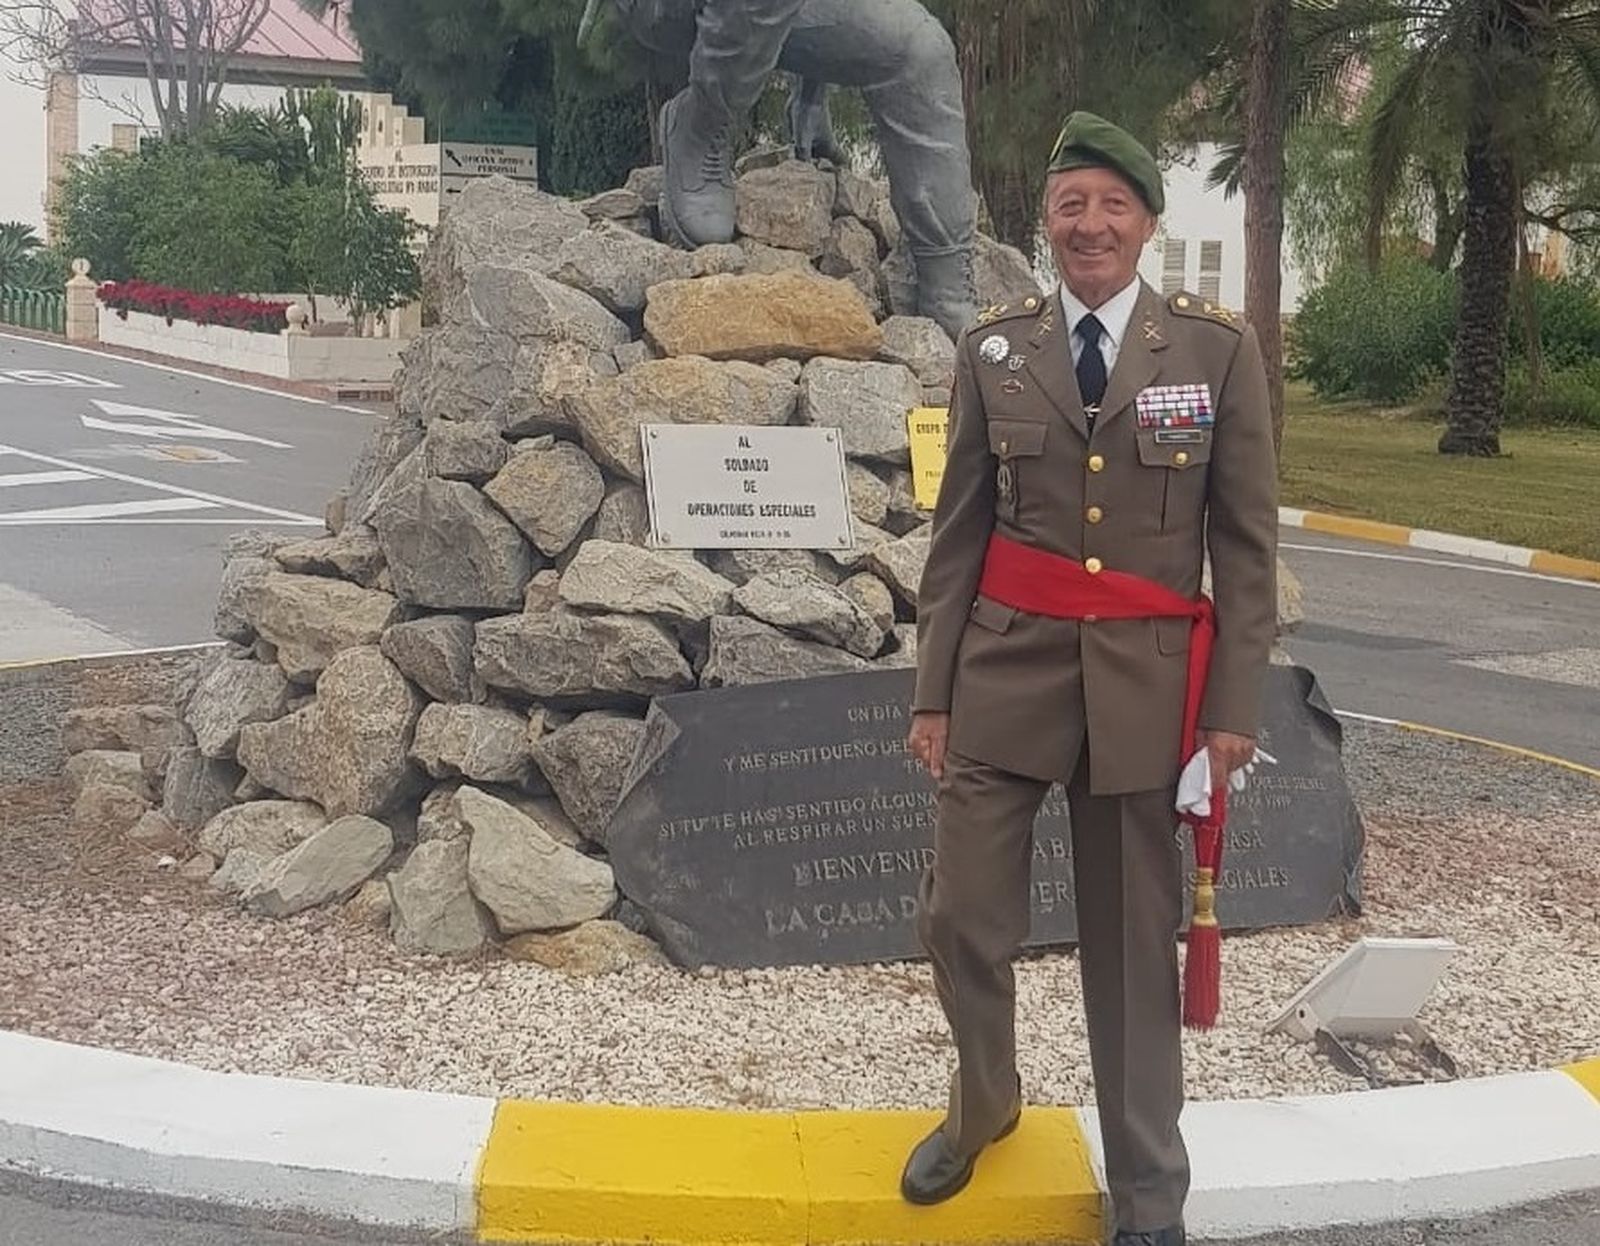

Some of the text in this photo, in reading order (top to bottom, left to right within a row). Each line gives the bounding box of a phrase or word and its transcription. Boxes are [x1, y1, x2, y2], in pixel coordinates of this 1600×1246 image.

[738, 435, 752, 449] AL
[724, 458, 769, 472] SOLDADO
[743, 480, 757, 494] DE
[686, 503, 816, 518] OPERACIONES ESPECIALES
[847, 706, 869, 722] UN
[723, 757, 734, 773] Y
[740, 753, 766, 771] ME
[659, 821, 676, 840] SI
[711, 812, 737, 832] TE
[786, 797, 865, 820] SENTIDO
[734, 832, 758, 850] AL
[763, 819, 858, 845] RESPIRAR
[862, 816, 887, 832] UN
[792, 847, 938, 885] BIENVENID
[763, 906, 808, 935] LA
